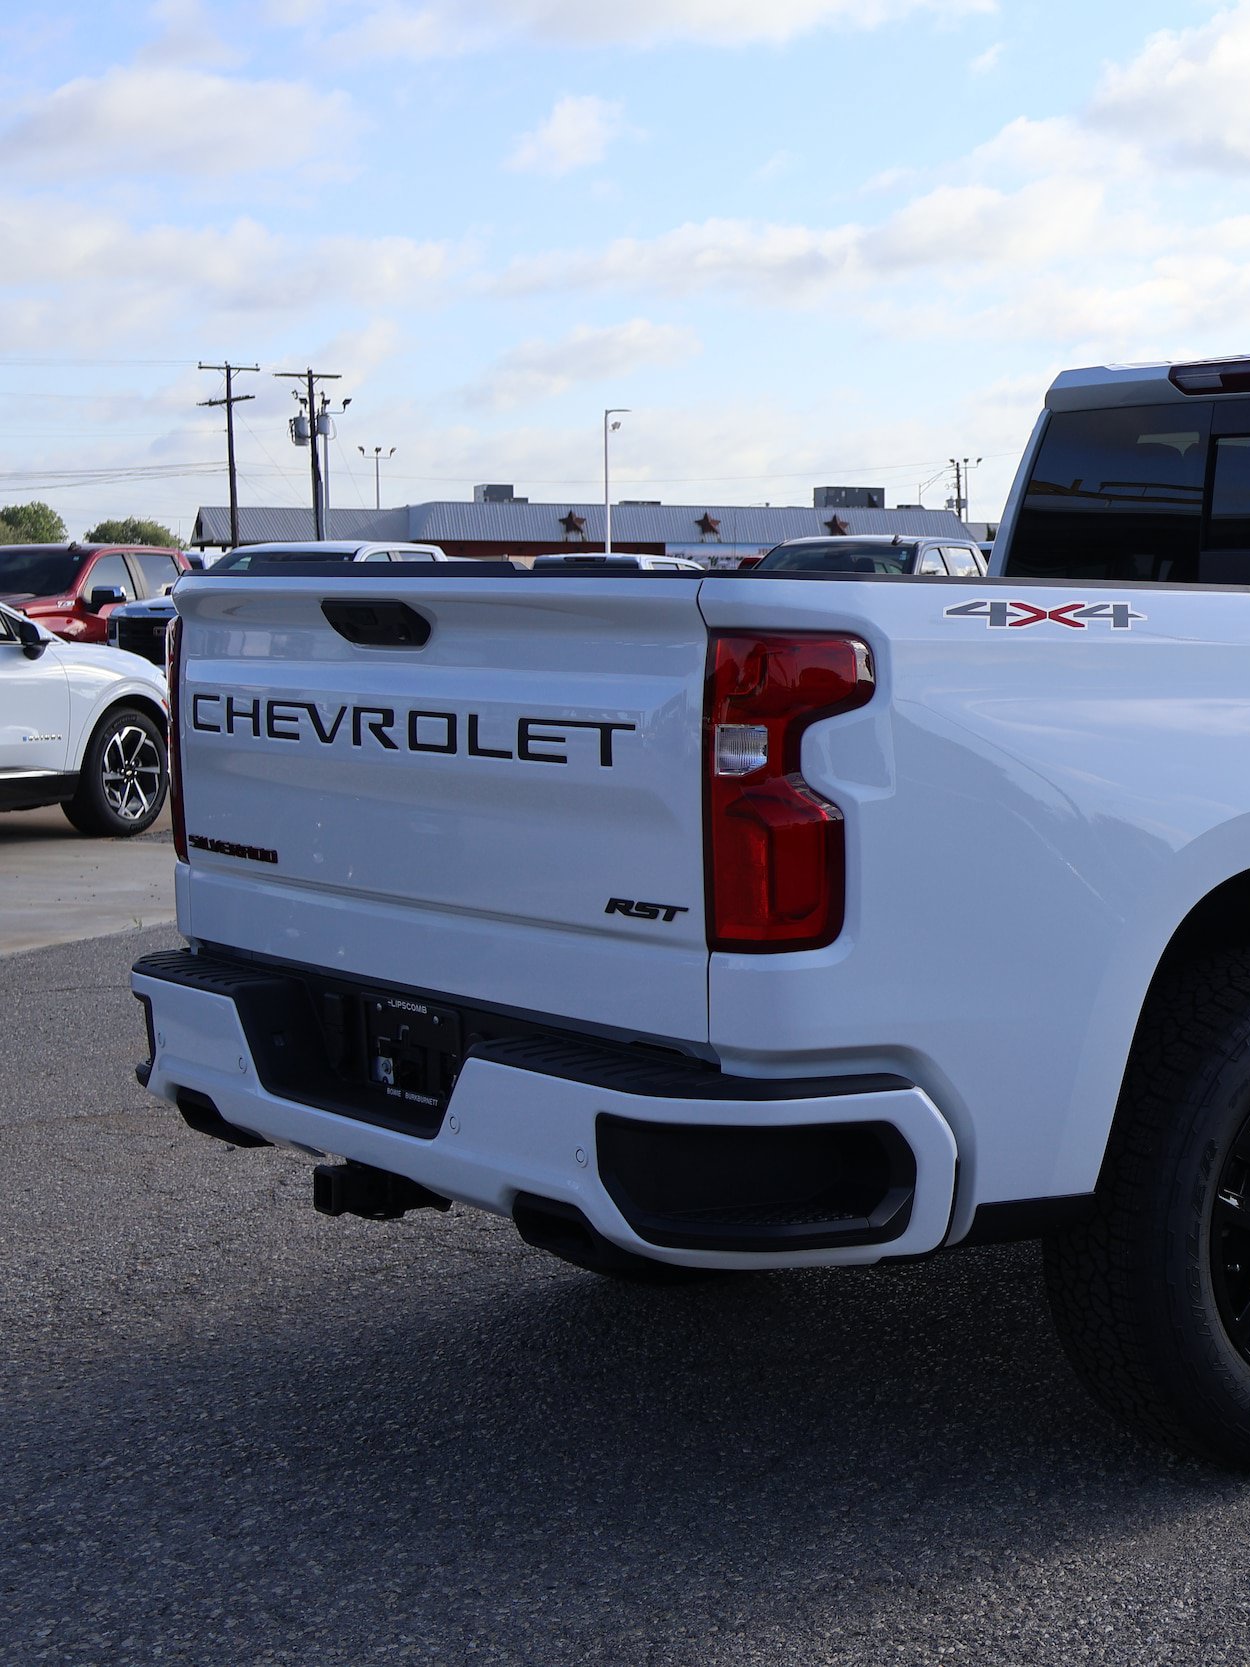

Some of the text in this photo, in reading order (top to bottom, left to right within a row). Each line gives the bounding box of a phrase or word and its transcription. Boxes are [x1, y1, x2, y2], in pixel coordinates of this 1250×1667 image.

[944, 600, 1146, 629] 4X4
[192, 693, 636, 767] CHEVROLET
[188, 834, 279, 864] SILVERADO
[605, 898, 689, 922] RST
